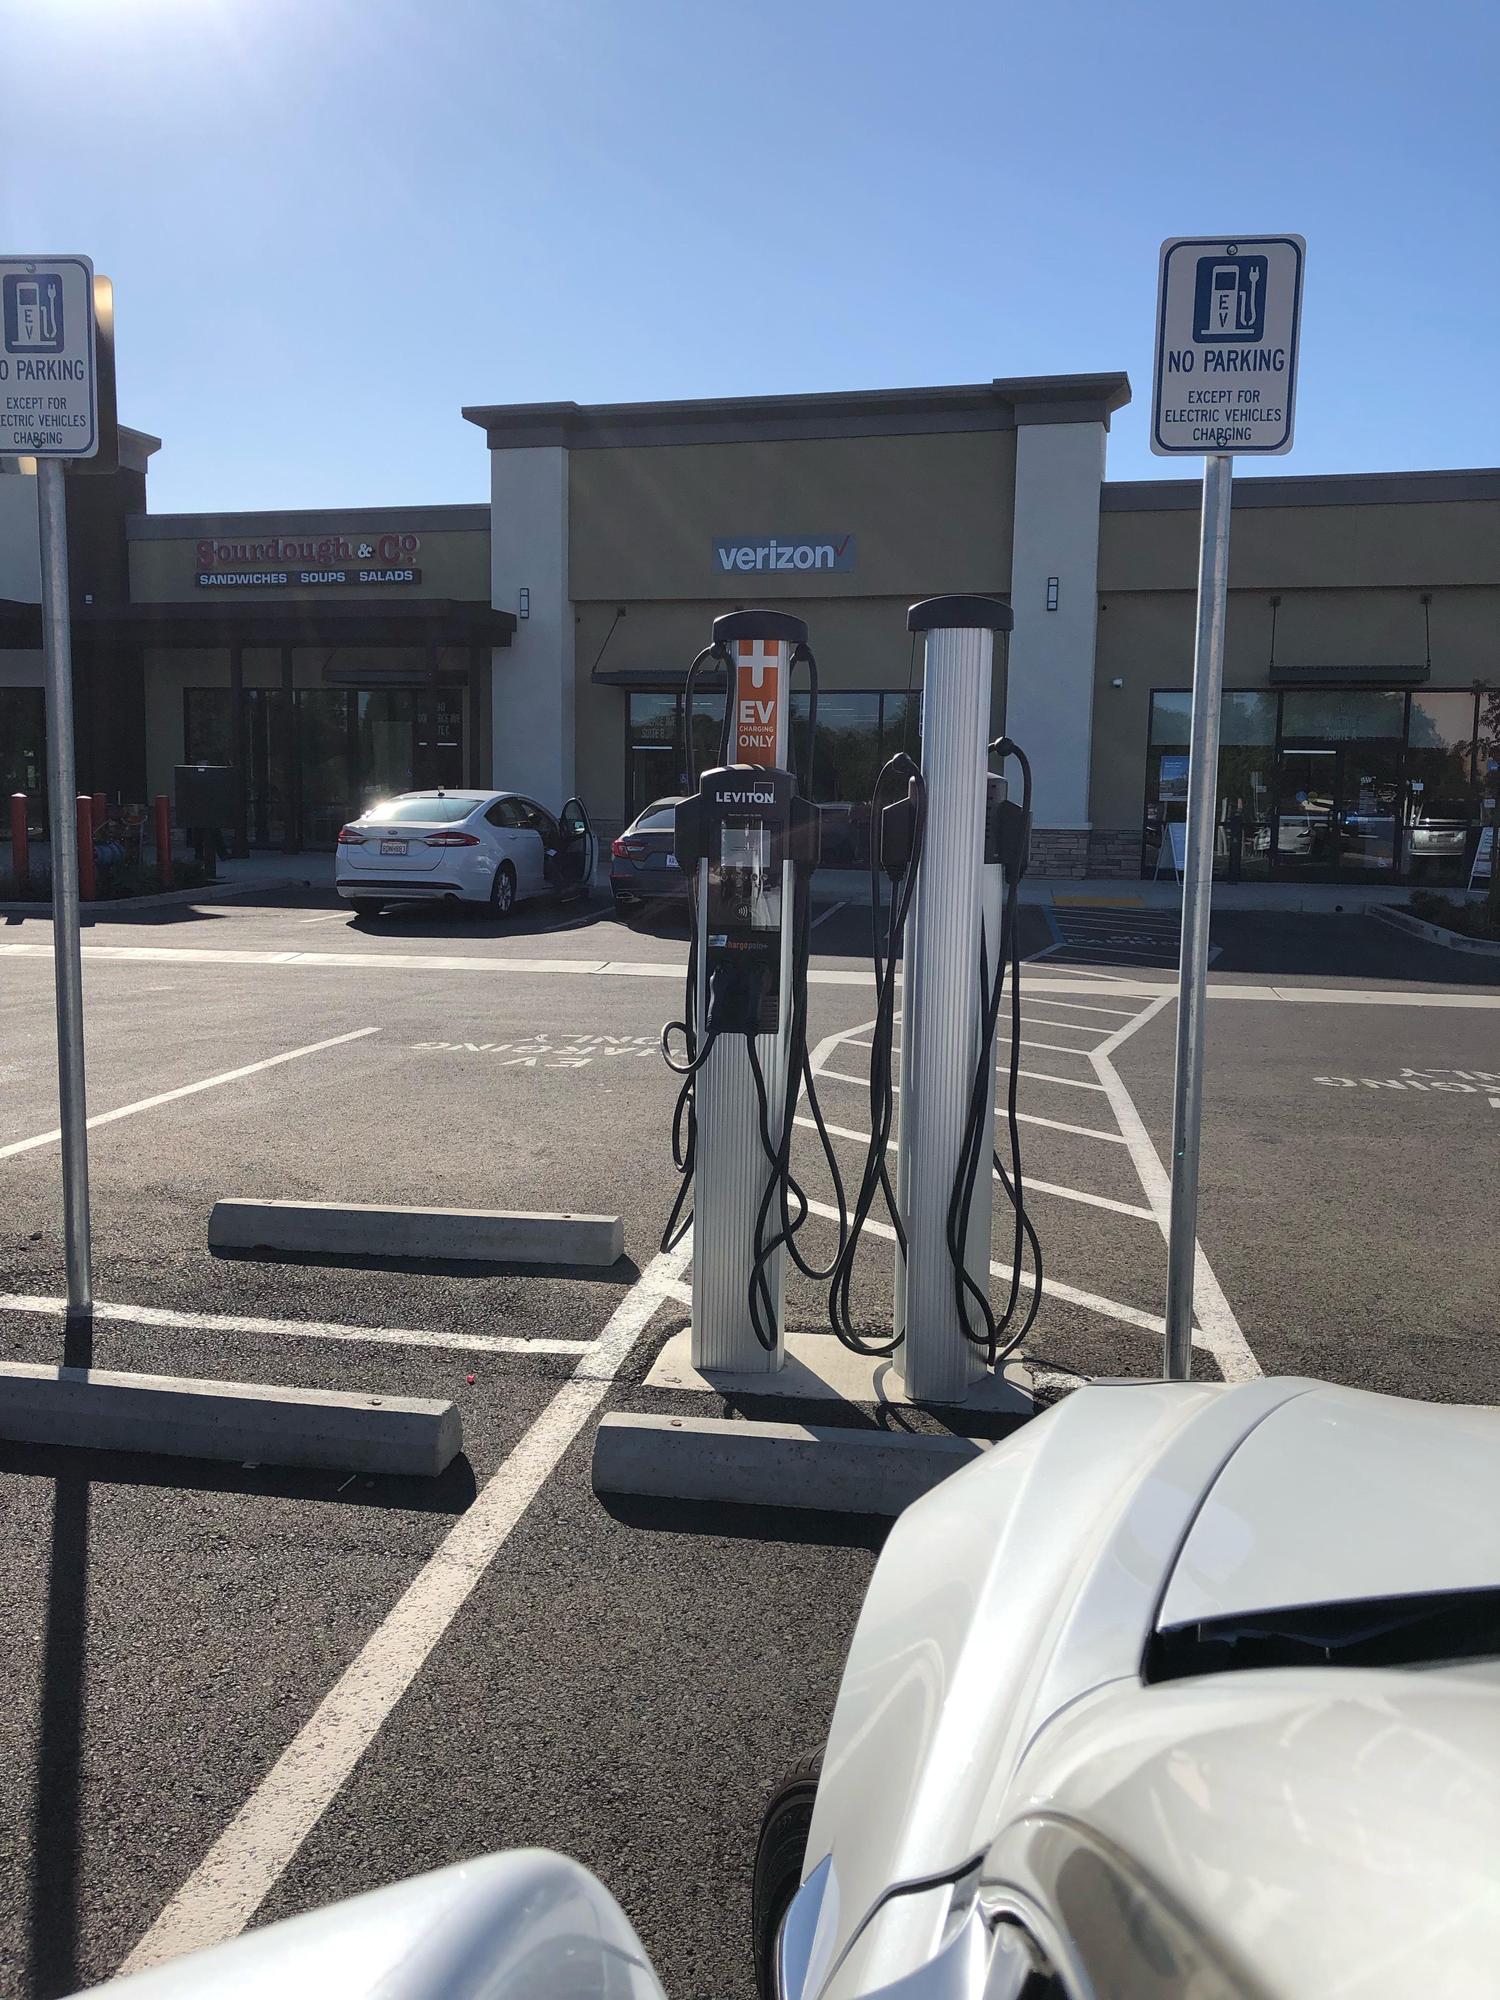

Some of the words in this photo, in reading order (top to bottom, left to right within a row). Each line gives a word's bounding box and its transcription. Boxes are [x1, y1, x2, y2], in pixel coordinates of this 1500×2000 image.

[1167, 350, 1195, 373] NO
[1203, 348, 1286, 373] PARKING
[0, 359, 9, 381] O
[16, 359, 85, 381] PARKING
[6, 397, 43, 410] EXCEPT
[47, 397, 67, 410] FOR
[1188, 390, 1233, 404] EXCEPT
[1237, 389, 1261, 403] FOR
[0, 414, 35, 427] ECTRIC
[38, 414, 87, 427] VEHICLES
[1164, 409, 1220, 423] ELECTRIC
[1225, 408, 1282, 422] VEHICLES
[13, 431, 63, 445] CHARGING
[1192, 427, 1252, 442] CHARGING
[357, 543, 373, 558] &
[719, 540, 835, 570] verizon
[199, 573, 288, 586] SANDWICHES
[300, 571, 346, 583] SOUPS
[359, 570, 414, 582] SALADS
[739, 700, 775, 724] EV
[739, 725, 774, 733] CHARGING
[739, 734, 775, 748] ONLY
[715, 791, 775, 804] LEVITON
[410, 1041, 690, 1057] HARGING
